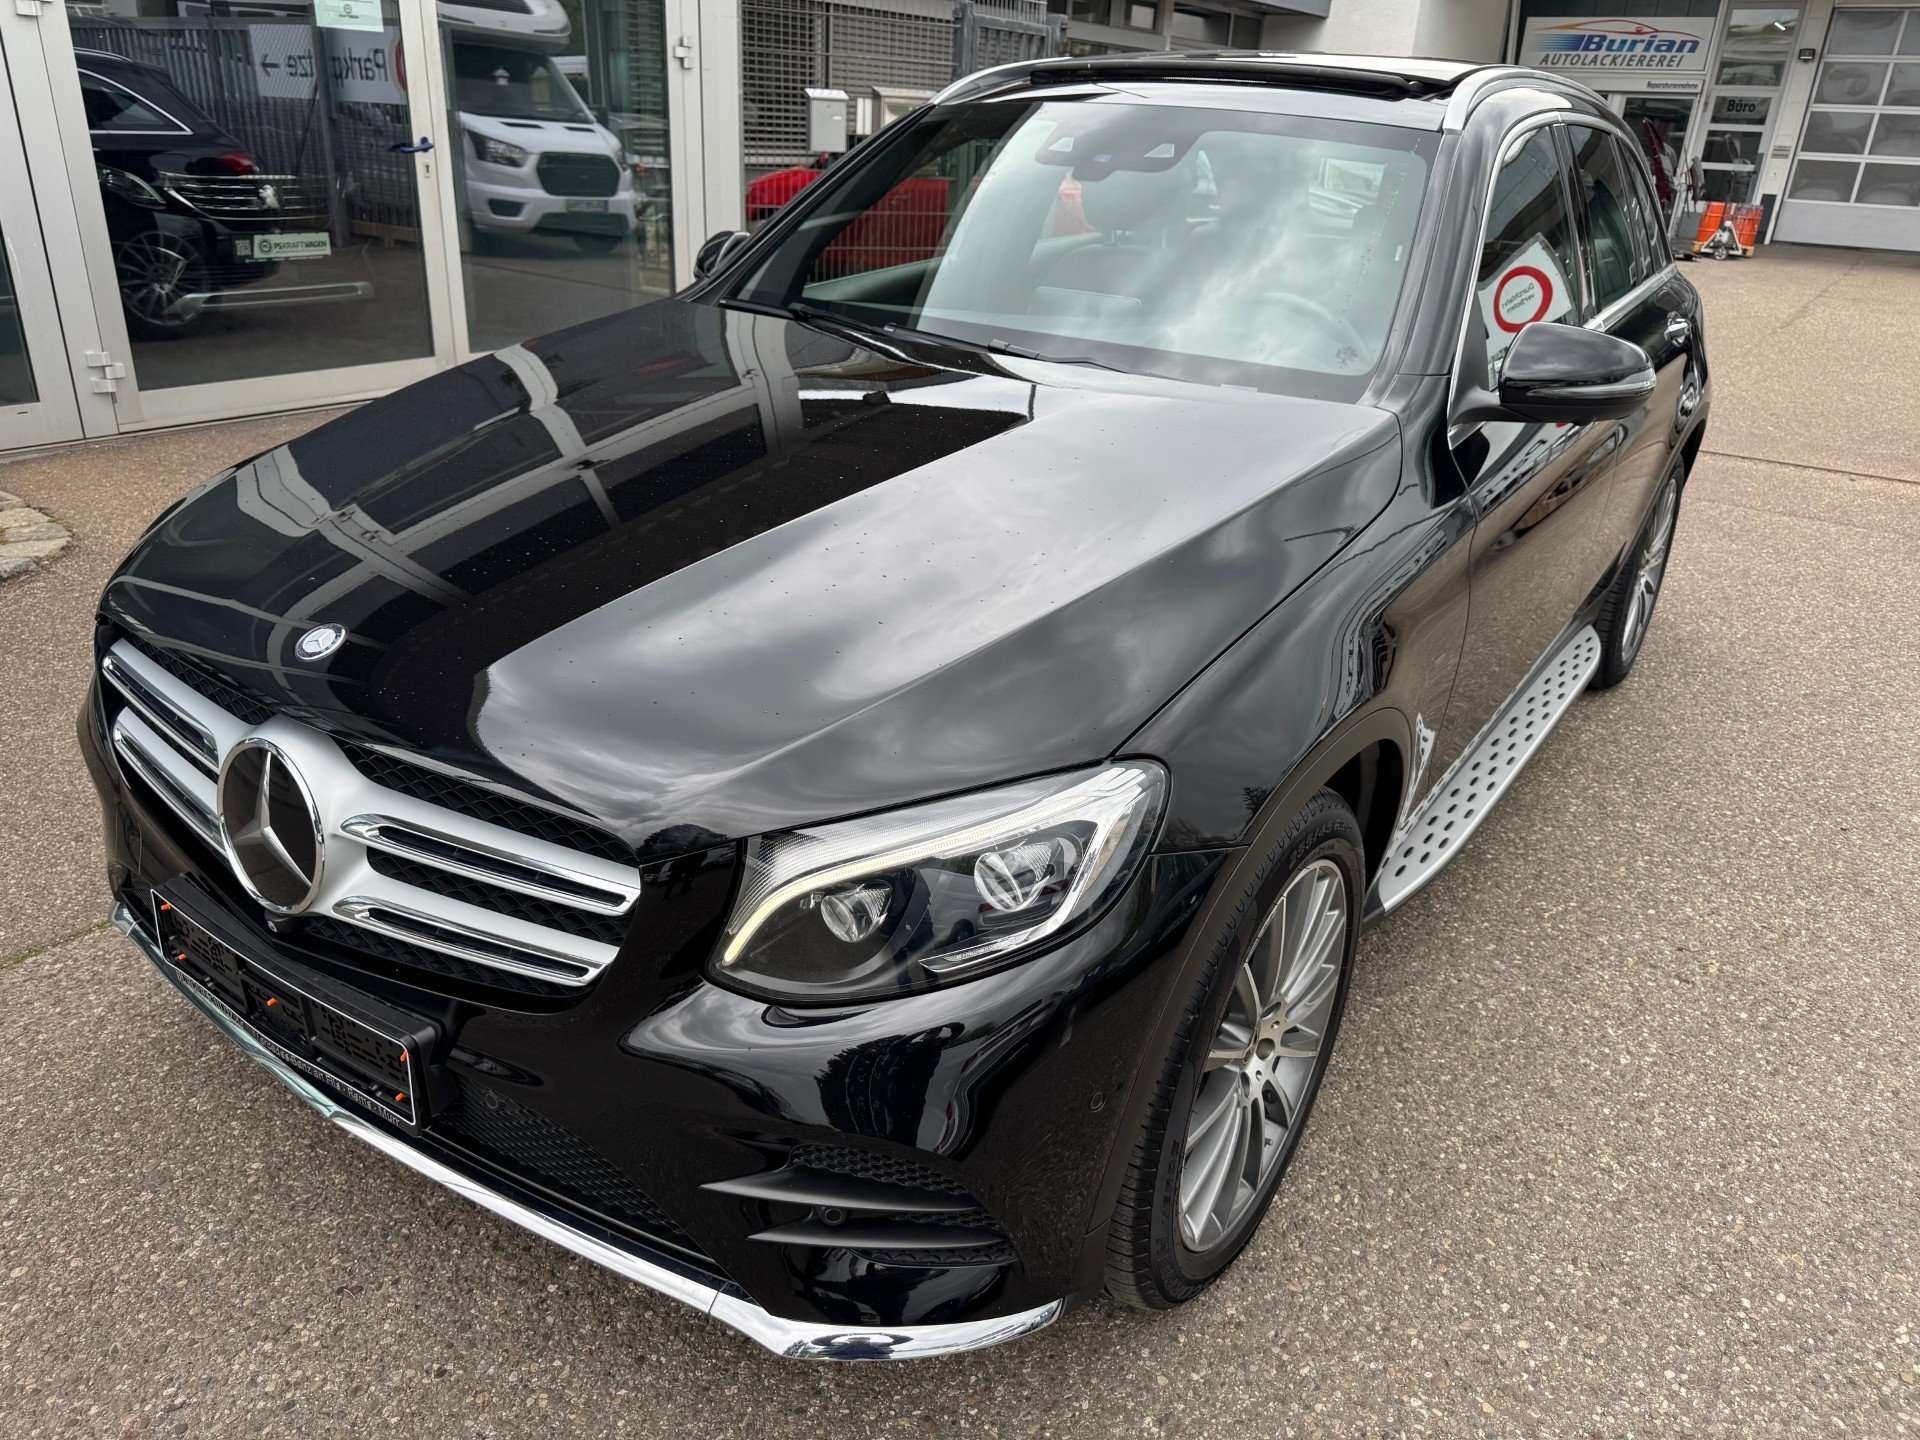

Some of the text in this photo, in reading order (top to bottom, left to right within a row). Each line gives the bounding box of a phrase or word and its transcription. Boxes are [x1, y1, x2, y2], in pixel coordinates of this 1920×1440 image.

[1580, 34, 1700, 53] Burian
[1539, 53, 1684, 68] AUTOLACKIEREREI
[1727, 98, 1756, 113] Büro
